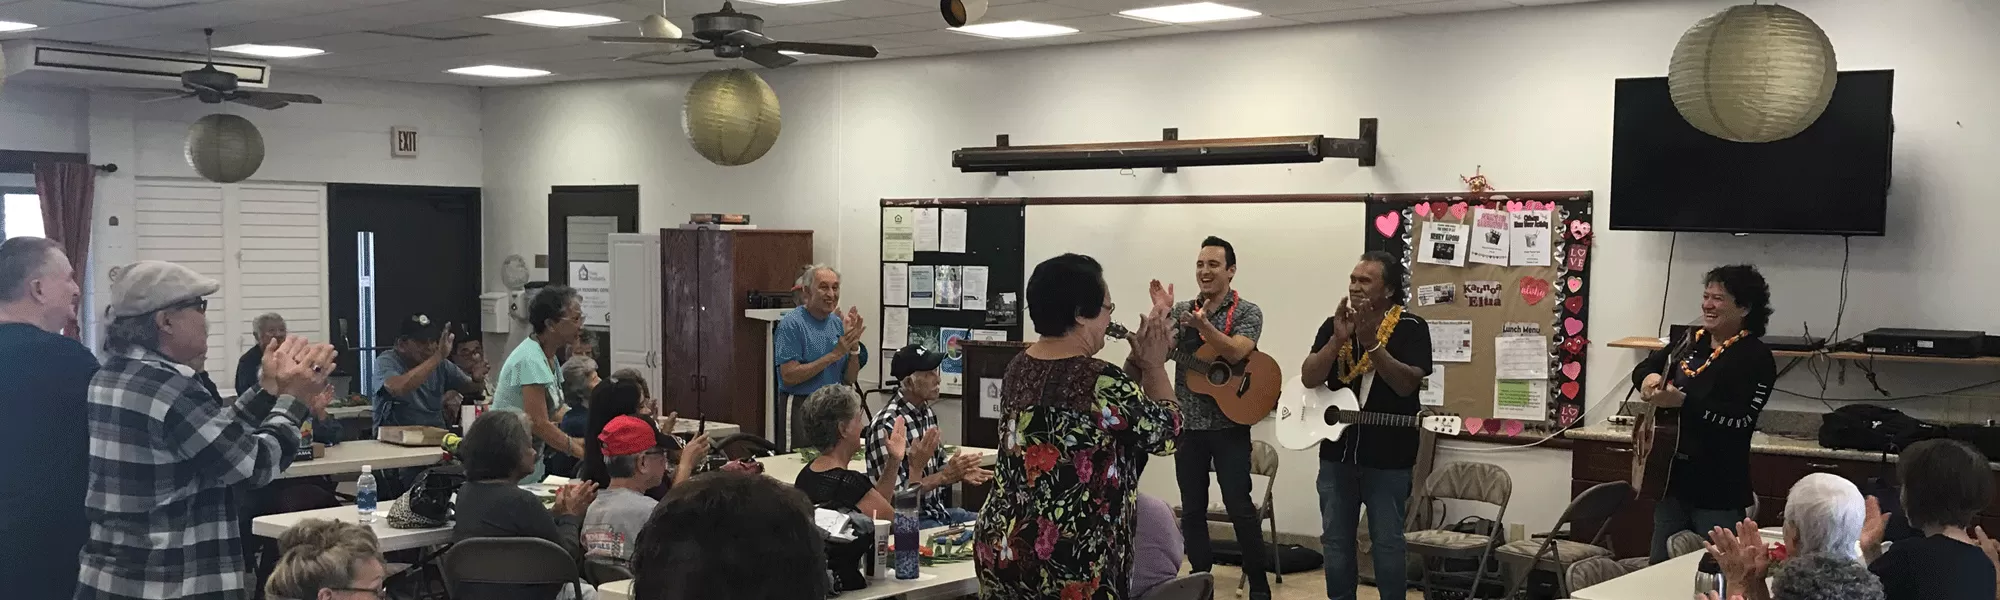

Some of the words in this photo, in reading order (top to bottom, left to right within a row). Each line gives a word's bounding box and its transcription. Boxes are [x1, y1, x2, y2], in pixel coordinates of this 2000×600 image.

[398, 130, 417, 152] EXIT
[1463, 283, 1502, 295] Kaunoa
[1521, 285, 1545, 297] aloha
[1502, 325, 1521, 333] Lunch
[1750, 382, 1767, 411] JIMI
